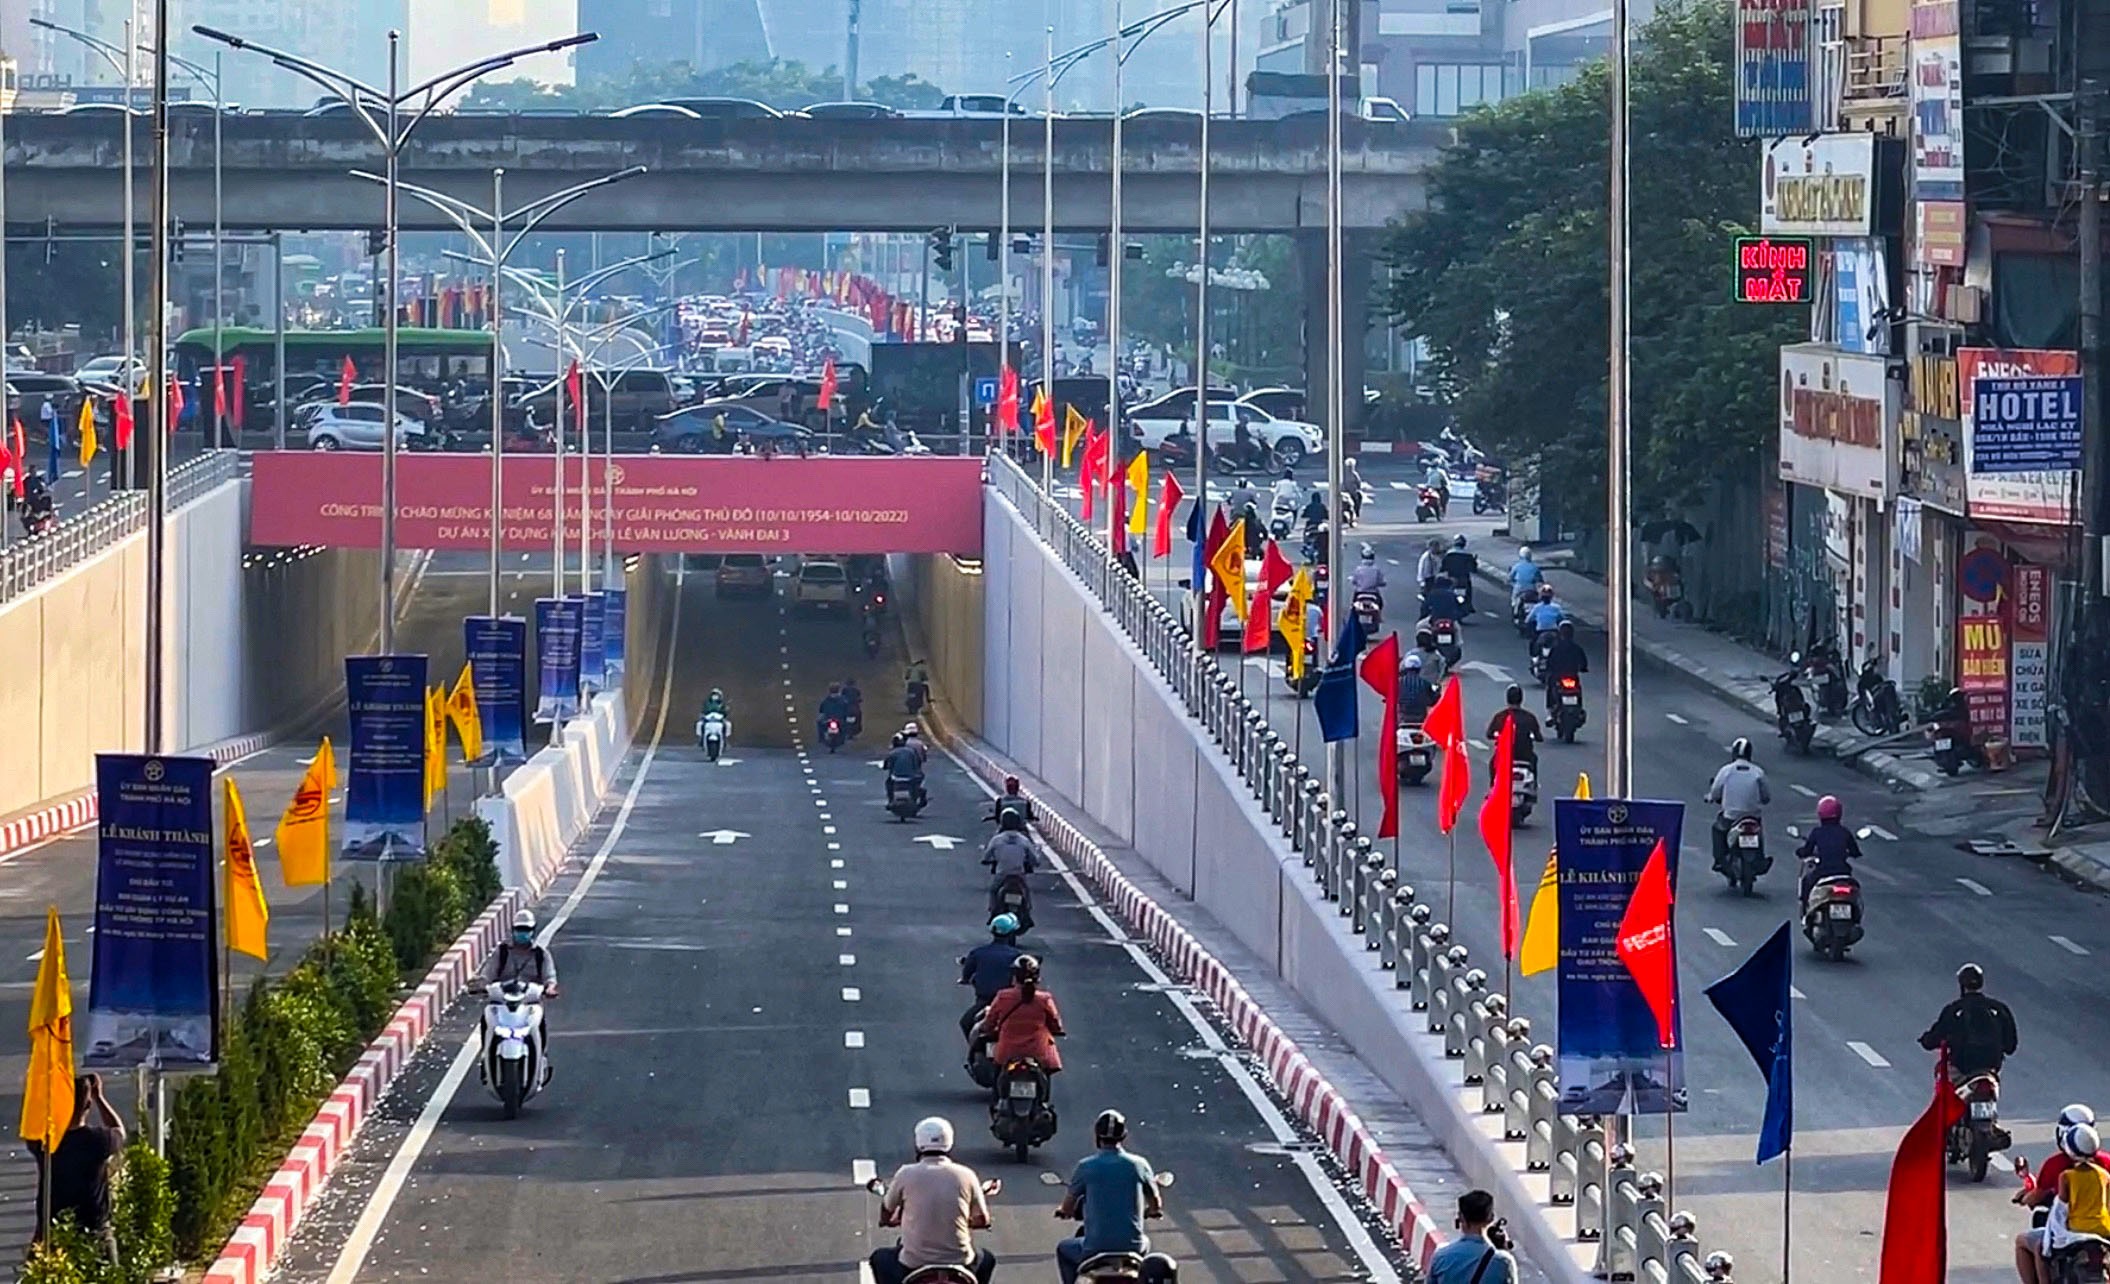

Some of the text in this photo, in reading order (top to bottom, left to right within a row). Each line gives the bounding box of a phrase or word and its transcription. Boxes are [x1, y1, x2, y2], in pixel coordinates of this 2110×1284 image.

[1741, 240, 1806, 269] KÍNH
[1979, 392, 2077, 421] HOTEL
[321, 504, 358, 517] CÔNG
[782, 528, 790, 541] 3
[2029, 570, 2041, 624] ENEOS
[120, 826, 160, 841] KHÁNH
[163, 828, 209, 844] THÀNH
